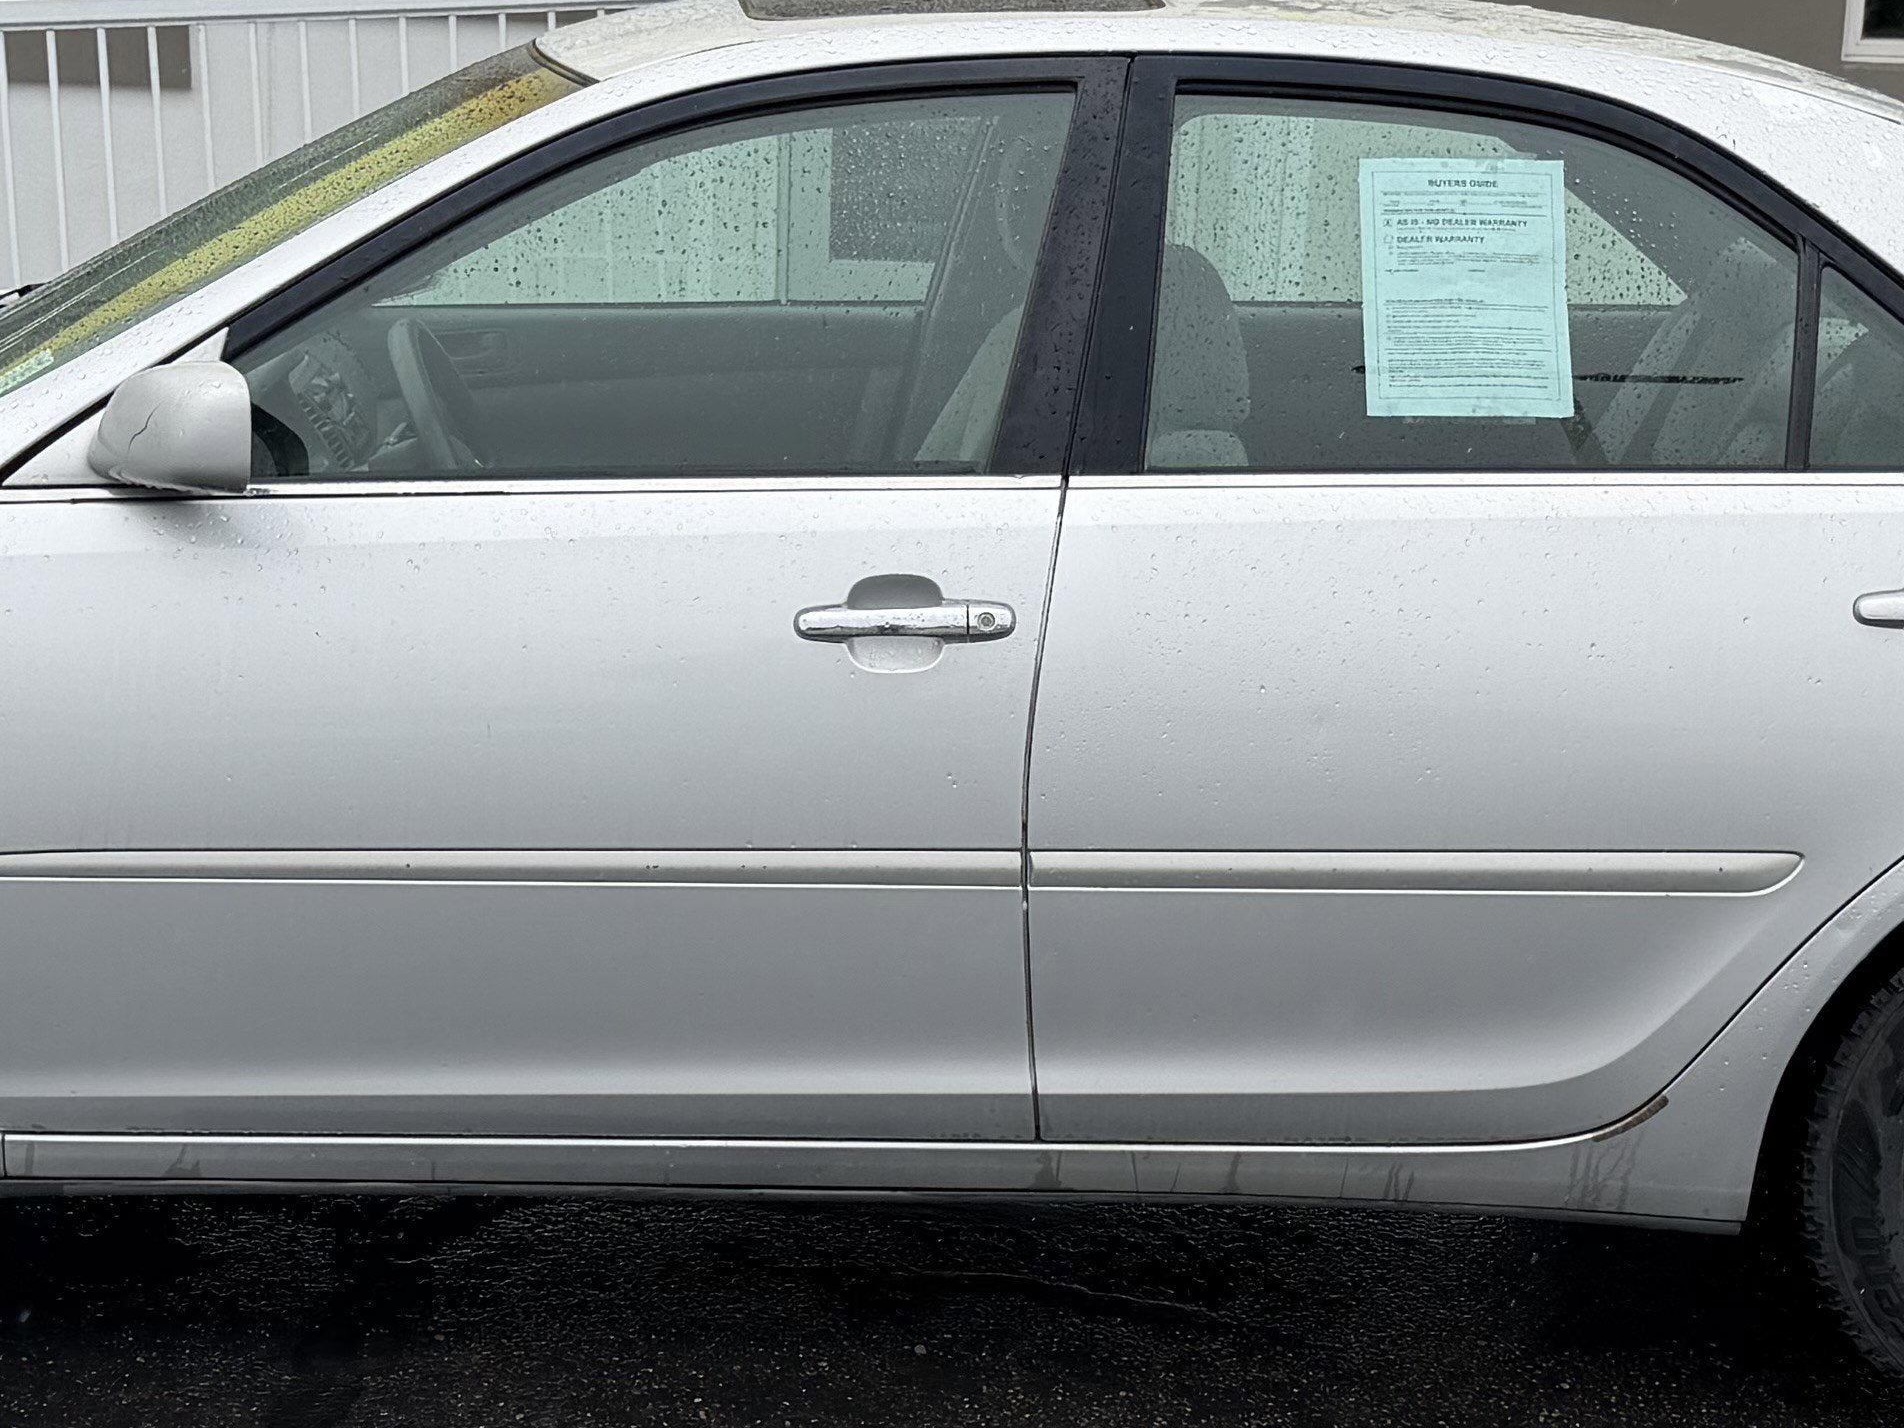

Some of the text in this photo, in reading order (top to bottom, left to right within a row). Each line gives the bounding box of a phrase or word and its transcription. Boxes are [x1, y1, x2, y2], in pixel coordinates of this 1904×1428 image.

[1427, 179, 1499, 188] BUYERS GUIDE
[1396, 218, 1408, 226] AS
[1442, 218, 1477, 226] DEALER
[1479, 219, 1528, 227] WARRANTY
[1396, 235, 1485, 244] DEALER WARRANTY
